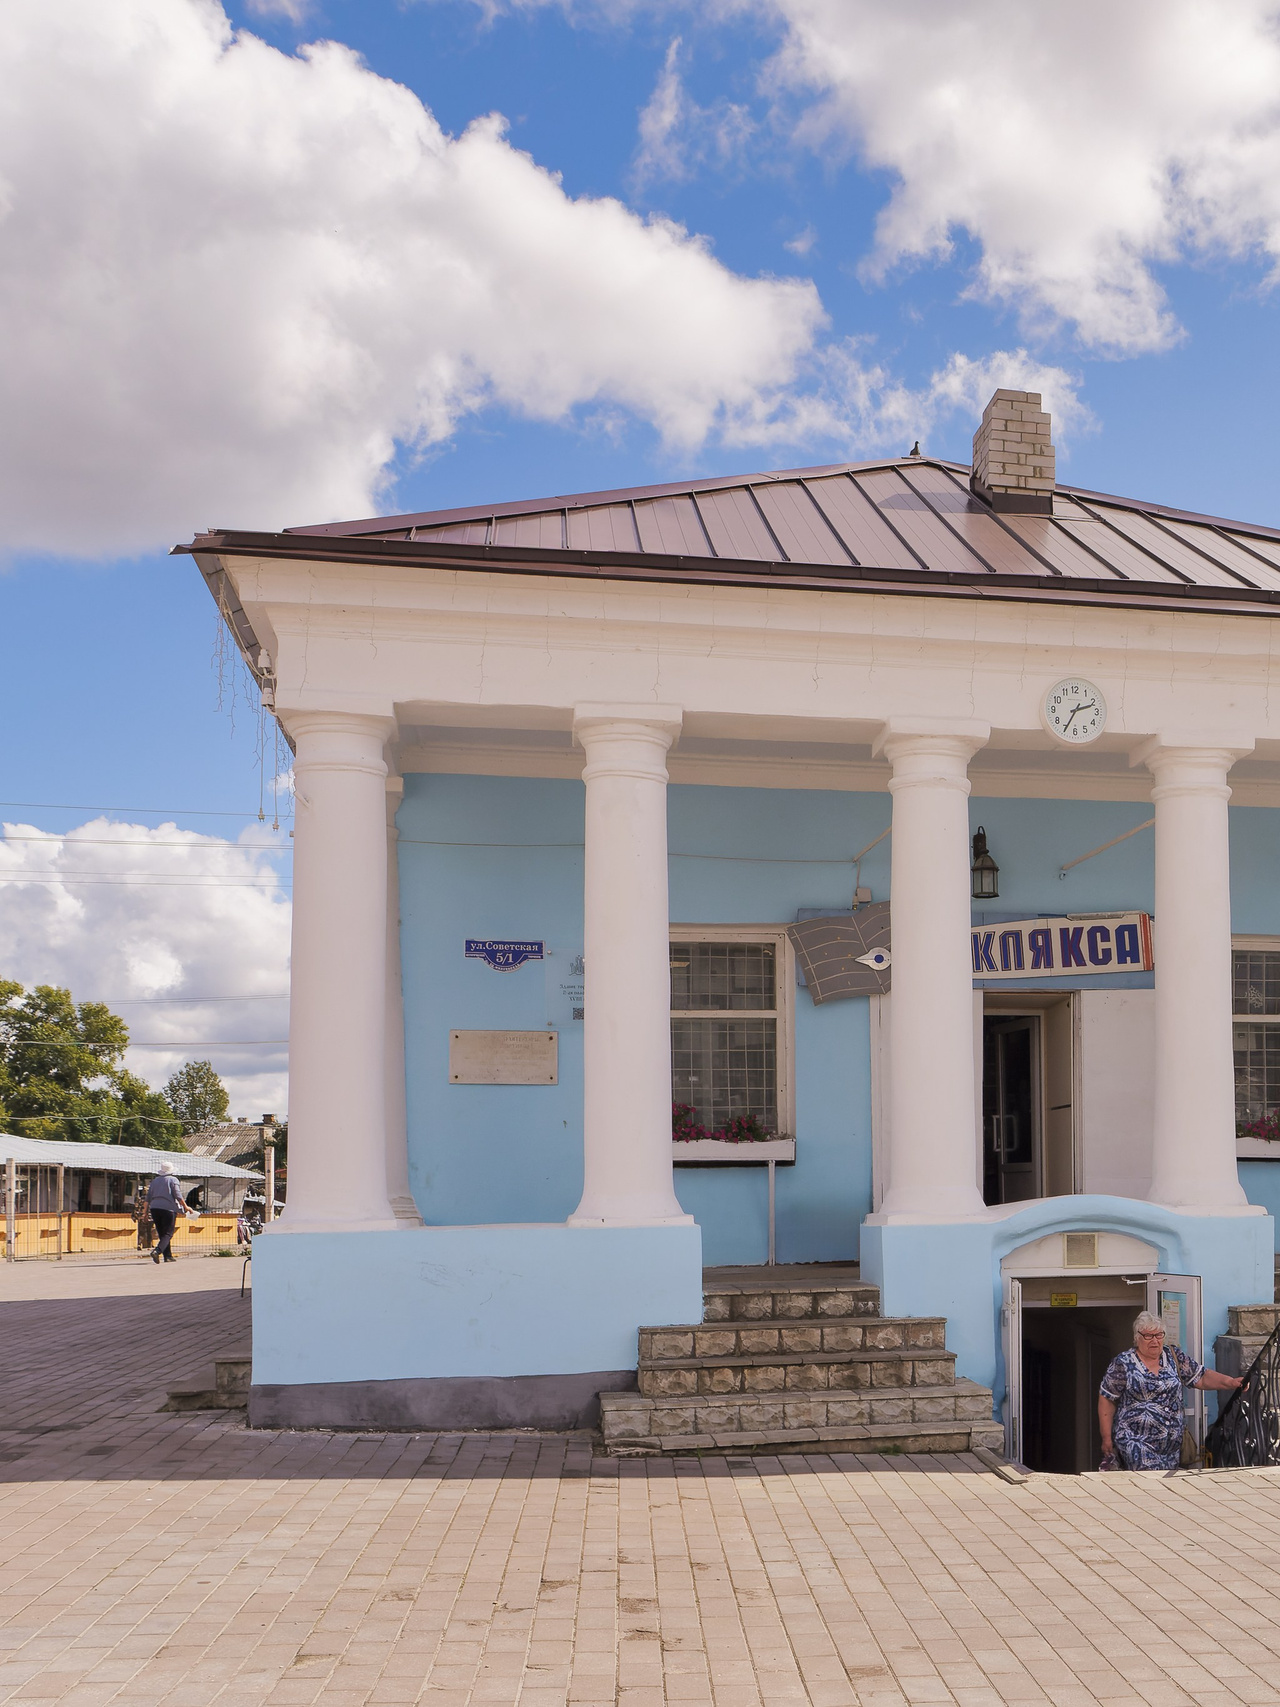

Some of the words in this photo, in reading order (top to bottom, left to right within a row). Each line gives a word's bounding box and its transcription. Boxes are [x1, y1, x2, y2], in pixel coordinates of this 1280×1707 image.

[1062, 688, 1068, 696] 11
[1071, 686, 1079, 694] 12
[1053, 696, 1062, 704] 10
[496, 952, 514, 965] 5/1
